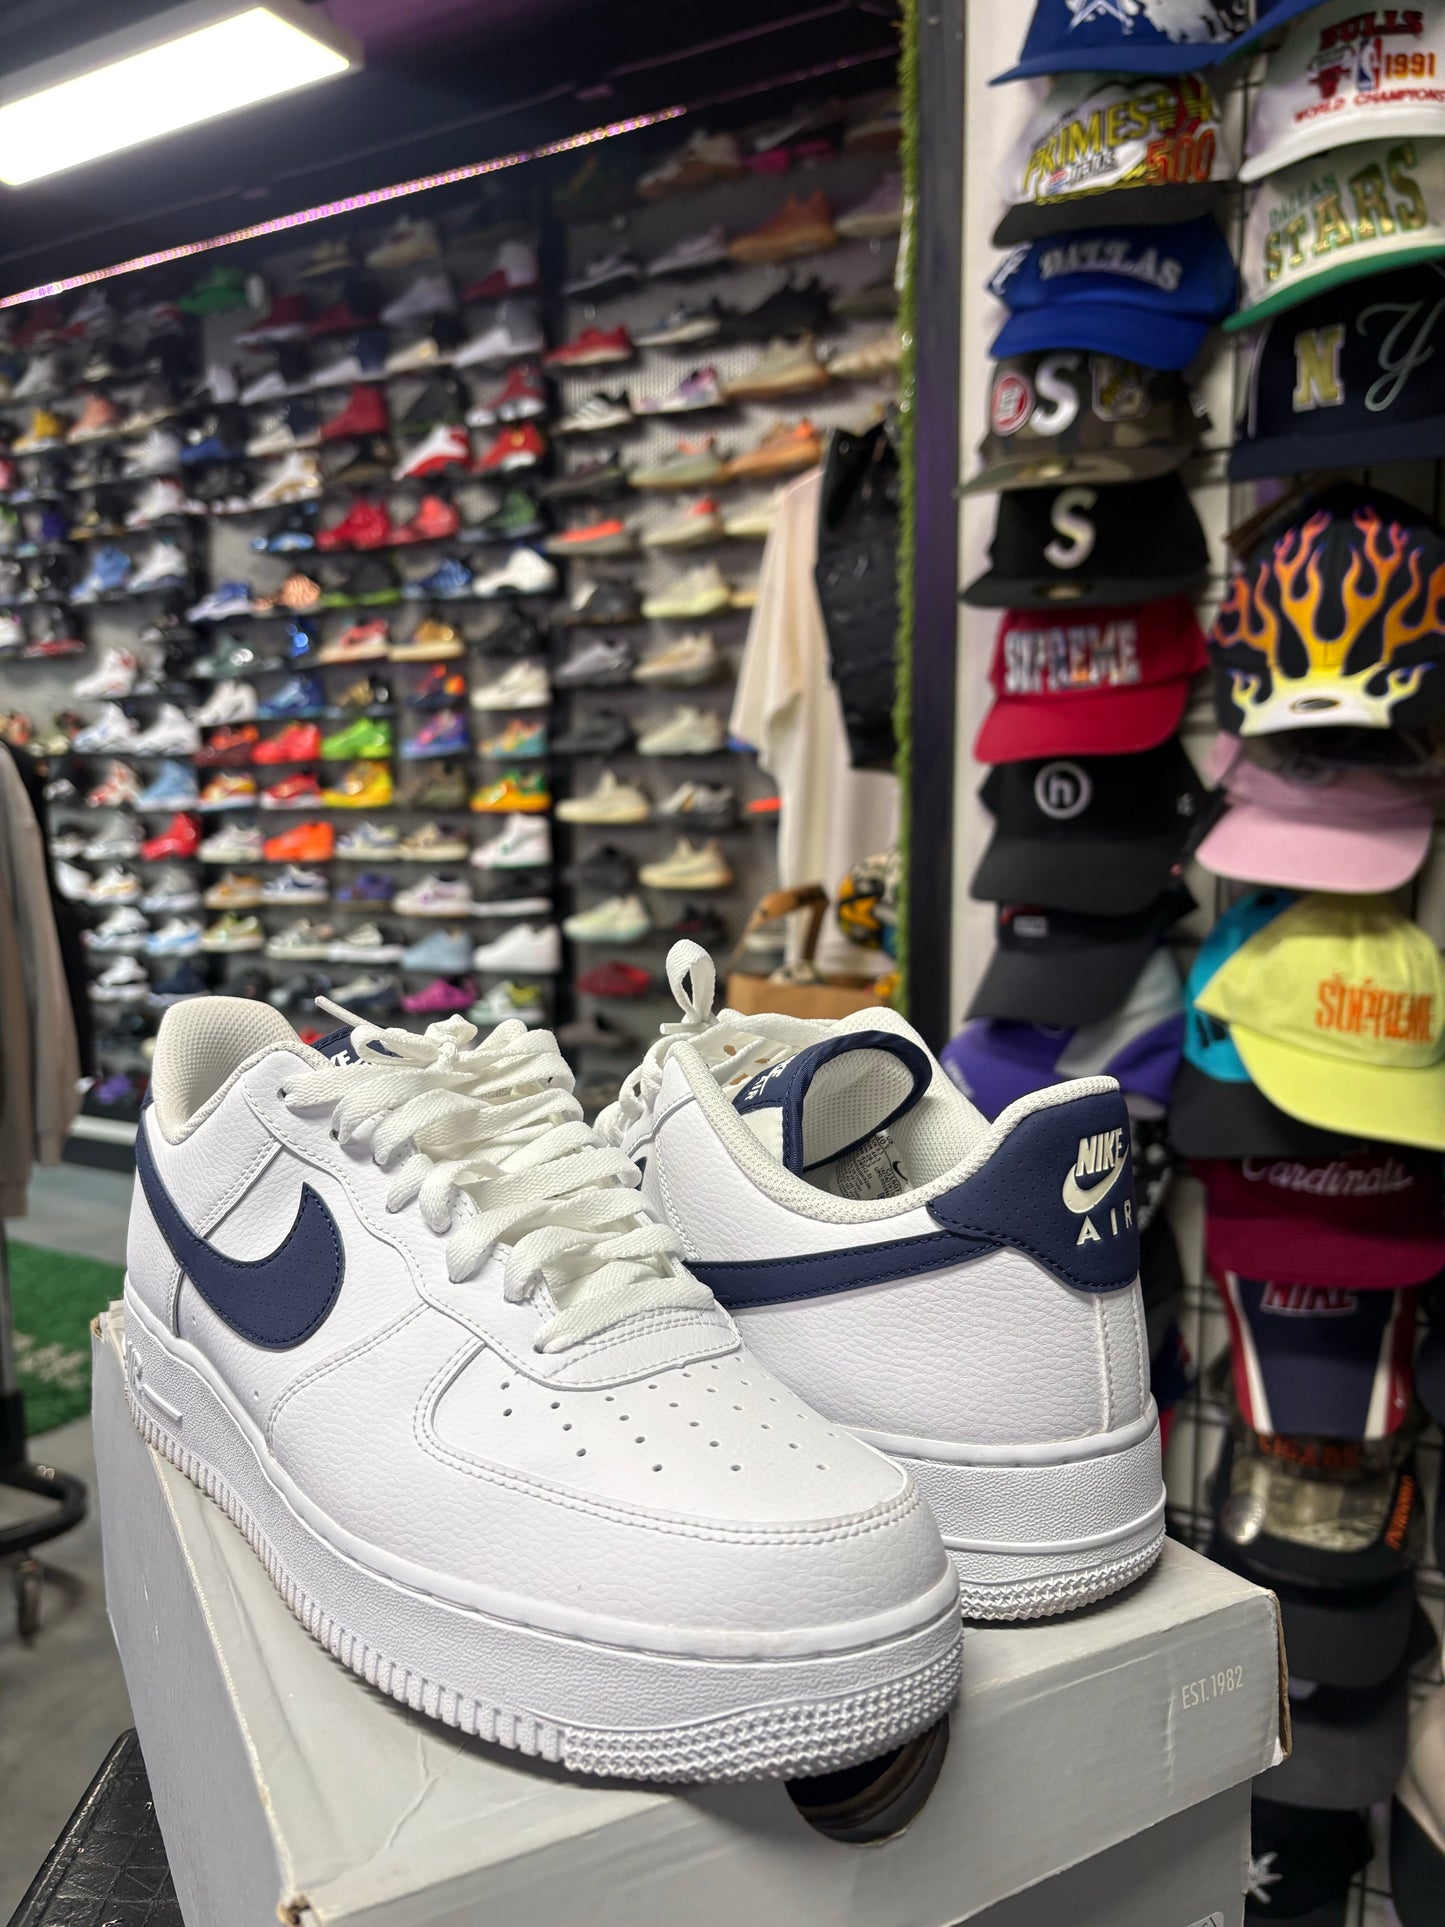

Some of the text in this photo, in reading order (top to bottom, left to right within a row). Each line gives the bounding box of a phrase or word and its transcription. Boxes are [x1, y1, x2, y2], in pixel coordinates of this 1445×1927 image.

[1319, 10, 1424, 50] BULLS
[1385, 52, 1436, 79] 1991
[1147, 128, 1217, 184] 500
[1264, 141, 1427, 283] STARS
[1029, 354, 1081, 436] S
[1043, 487, 1098, 570] S
[1076, 1127, 1122, 1177] NIKE
[1076, 1199, 1133, 1245] AIR
